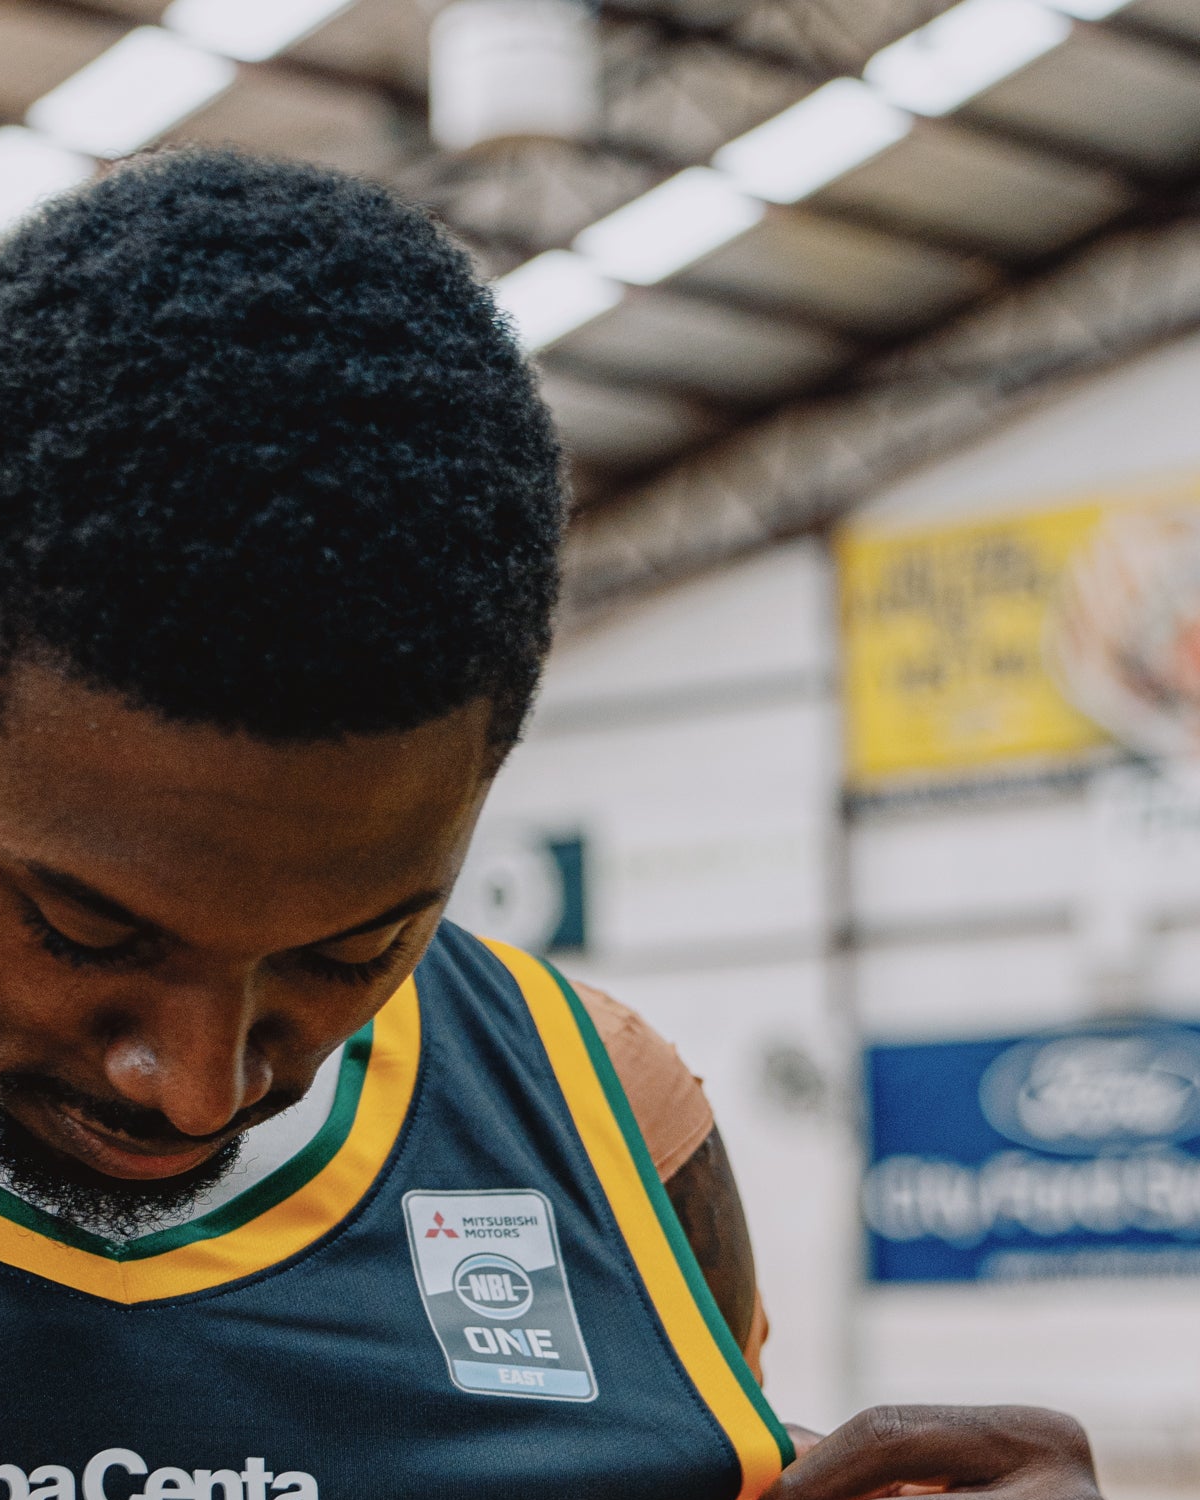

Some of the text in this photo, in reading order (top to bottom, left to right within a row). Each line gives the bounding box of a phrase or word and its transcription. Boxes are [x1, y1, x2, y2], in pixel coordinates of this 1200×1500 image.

[461, 1215, 538, 1227] MITSUBISHI
[464, 1228, 520, 1239] MOTORS
[468, 1273, 519, 1302] NBL
[463, 1326, 560, 1360] ONE
[499, 1367, 545, 1387] EAST
